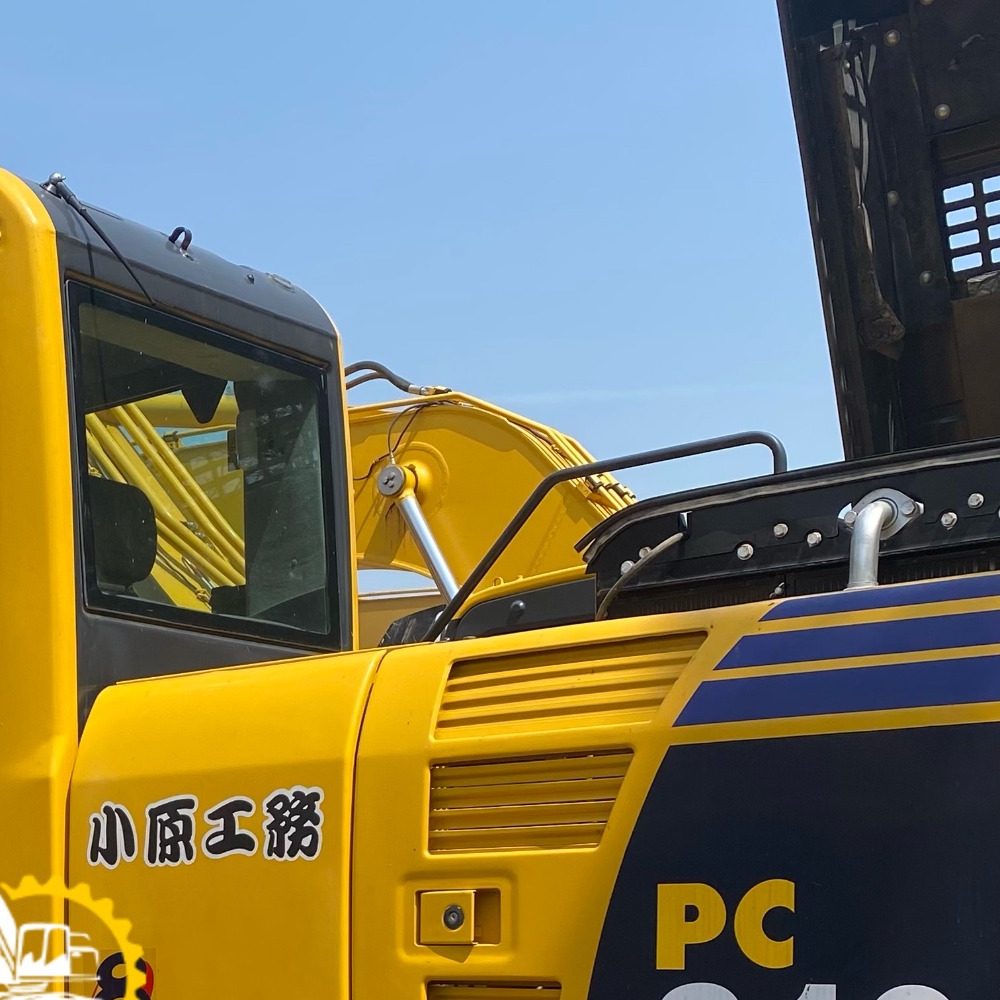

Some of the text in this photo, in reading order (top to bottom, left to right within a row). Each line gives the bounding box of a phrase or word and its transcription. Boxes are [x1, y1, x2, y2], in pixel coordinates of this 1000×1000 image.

[87, 785, 324, 870] 小原工務
[656, 879, 795, 970] PC
